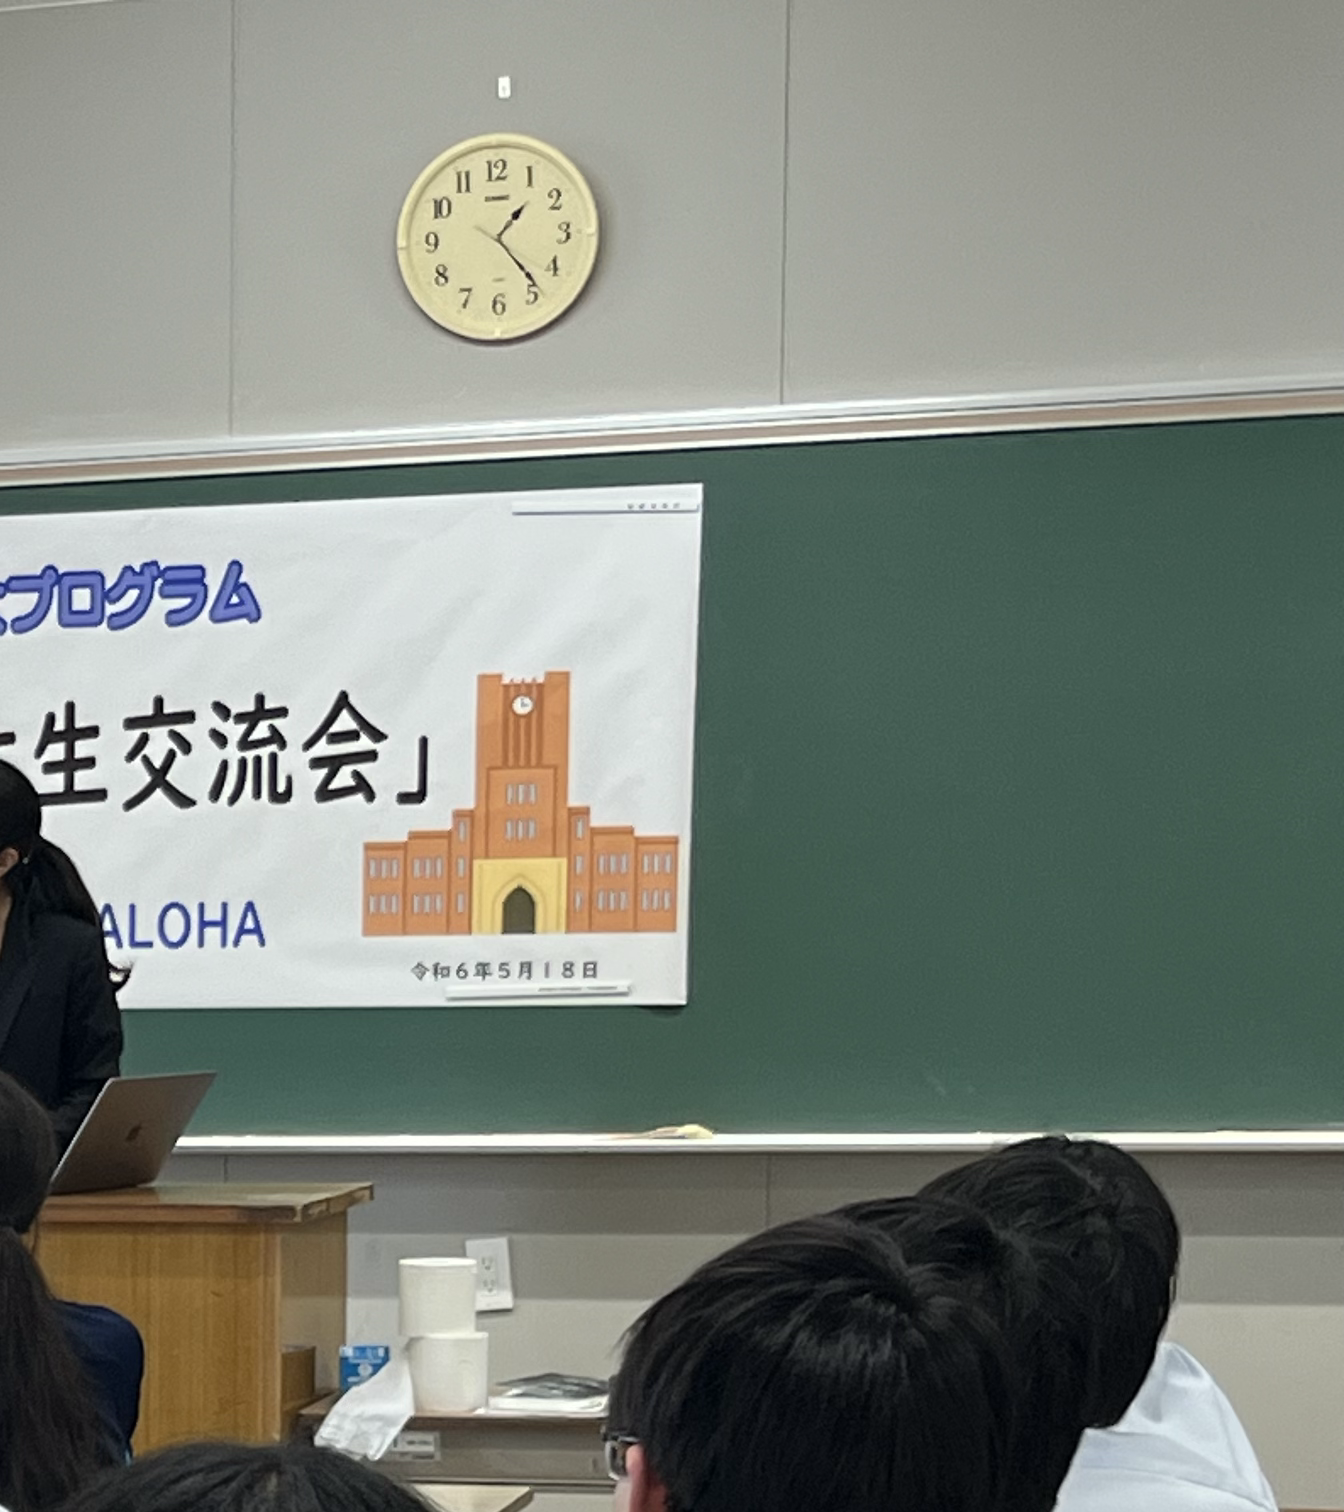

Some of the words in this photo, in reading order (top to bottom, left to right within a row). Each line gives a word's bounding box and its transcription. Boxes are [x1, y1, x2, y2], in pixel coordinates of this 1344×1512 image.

[455, 170, 471, 193] 11
[485, 159, 508, 182] 12
[525, 165, 535, 188] 1
[432, 196, 452, 219] 10
[547, 188, 562, 211] 2
[425, 231, 439, 253] 9
[556, 221, 571, 244] 3
[434, 264, 449, 286] 8
[545, 255, 559, 277] 4
[458, 287, 473, 309] 7
[491, 293, 506, 315] 6
[525, 283, 539, 306] 5
[99, 900, 266, 949] ALOHA
[411, 960, 599, 981] 令和6年5月18日
